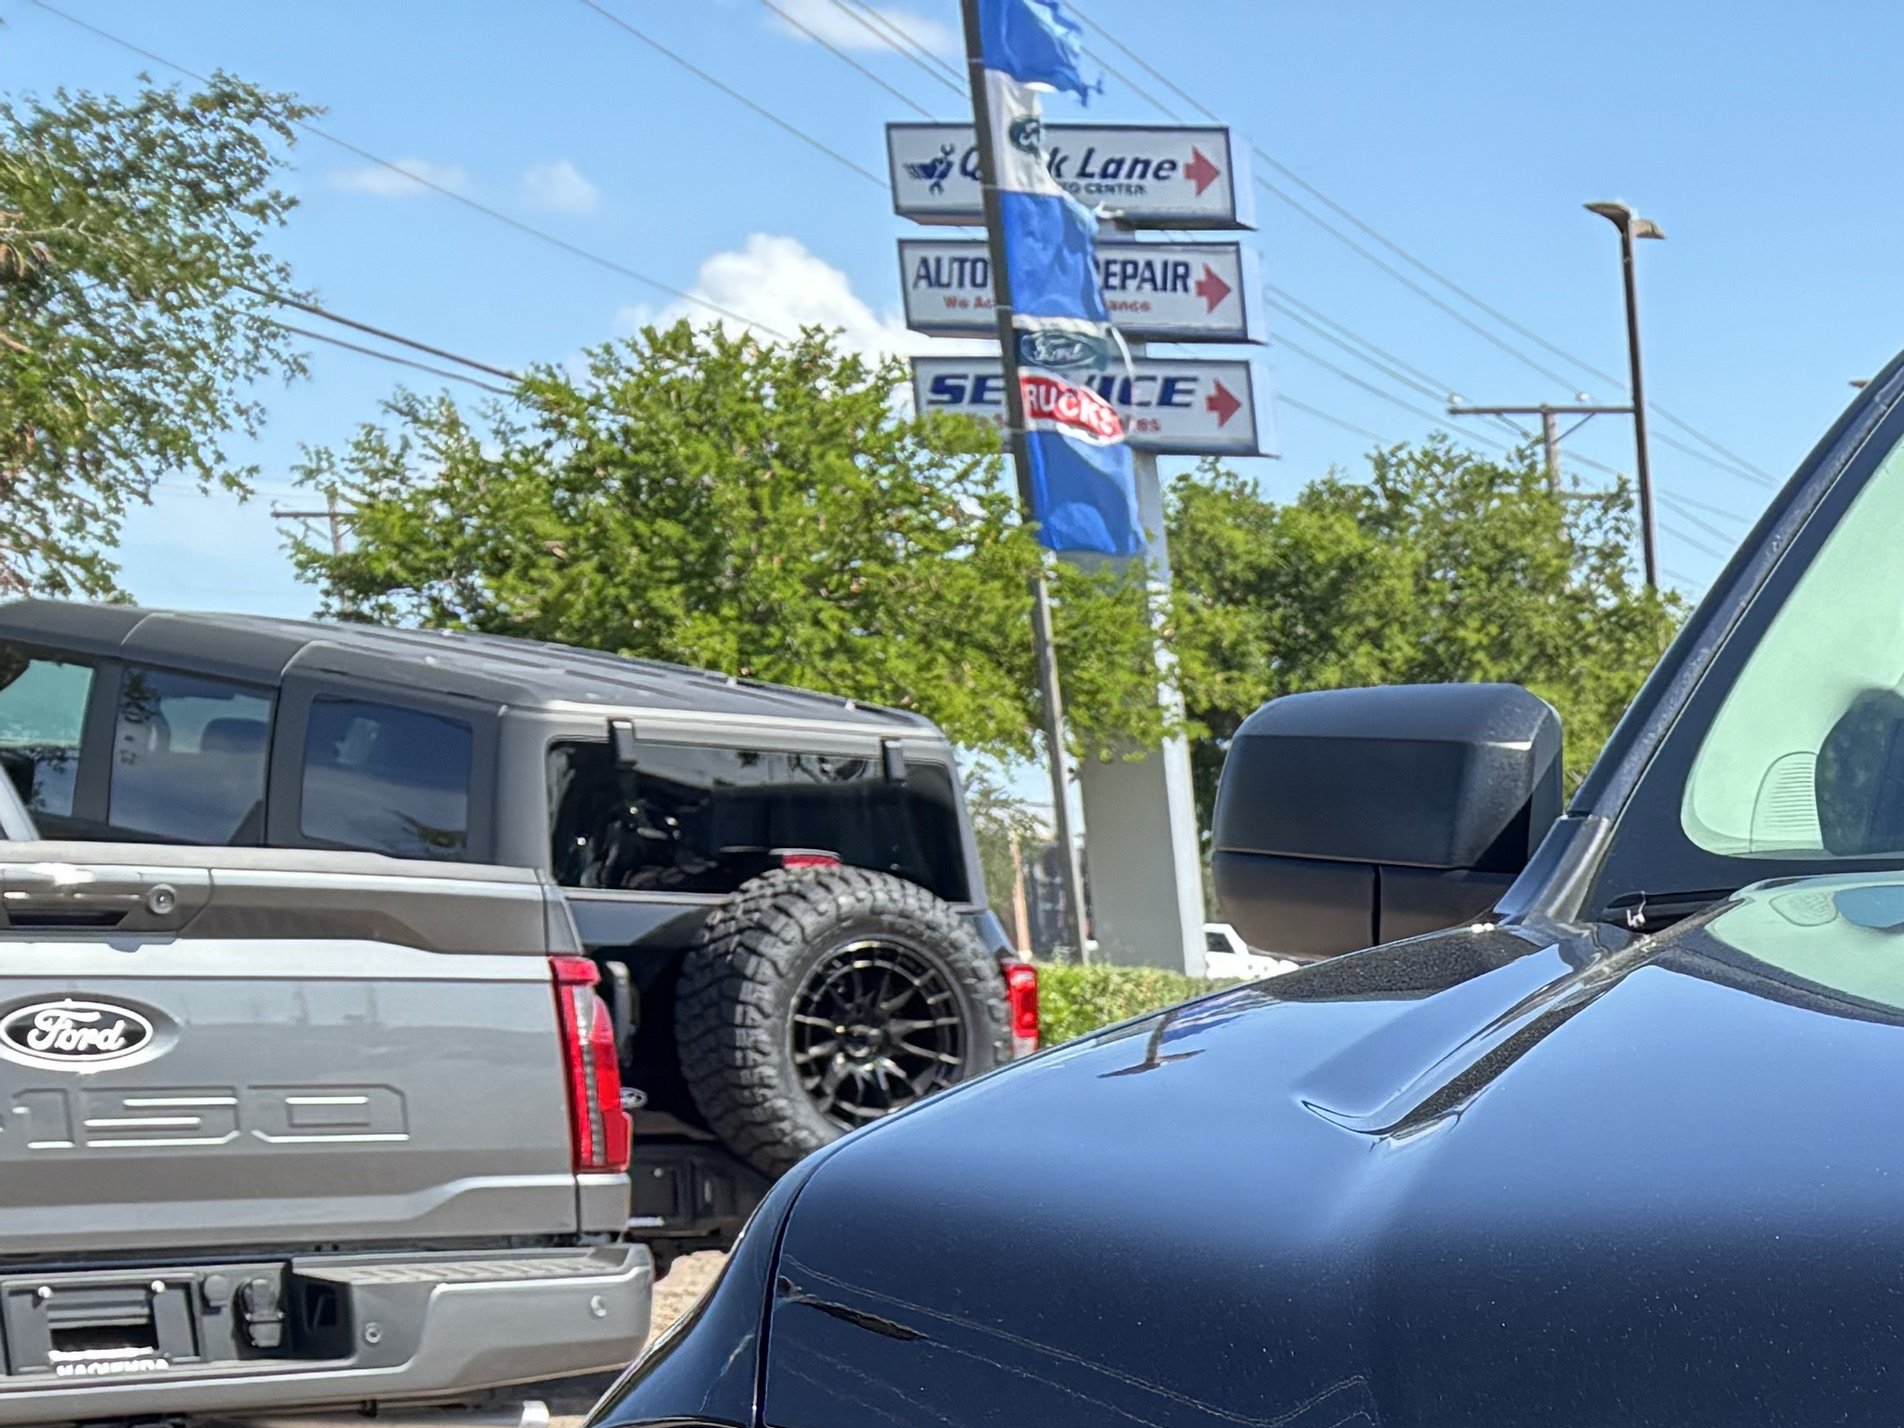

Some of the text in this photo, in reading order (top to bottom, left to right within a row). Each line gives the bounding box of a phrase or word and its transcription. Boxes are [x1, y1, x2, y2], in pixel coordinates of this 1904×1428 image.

[1076, 147, 1178, 181] Lane
[912, 255, 1190, 292] AUTO EPAIR
[927, 373, 1199, 409] SEICE
[27, 1008, 128, 1051] Ford
